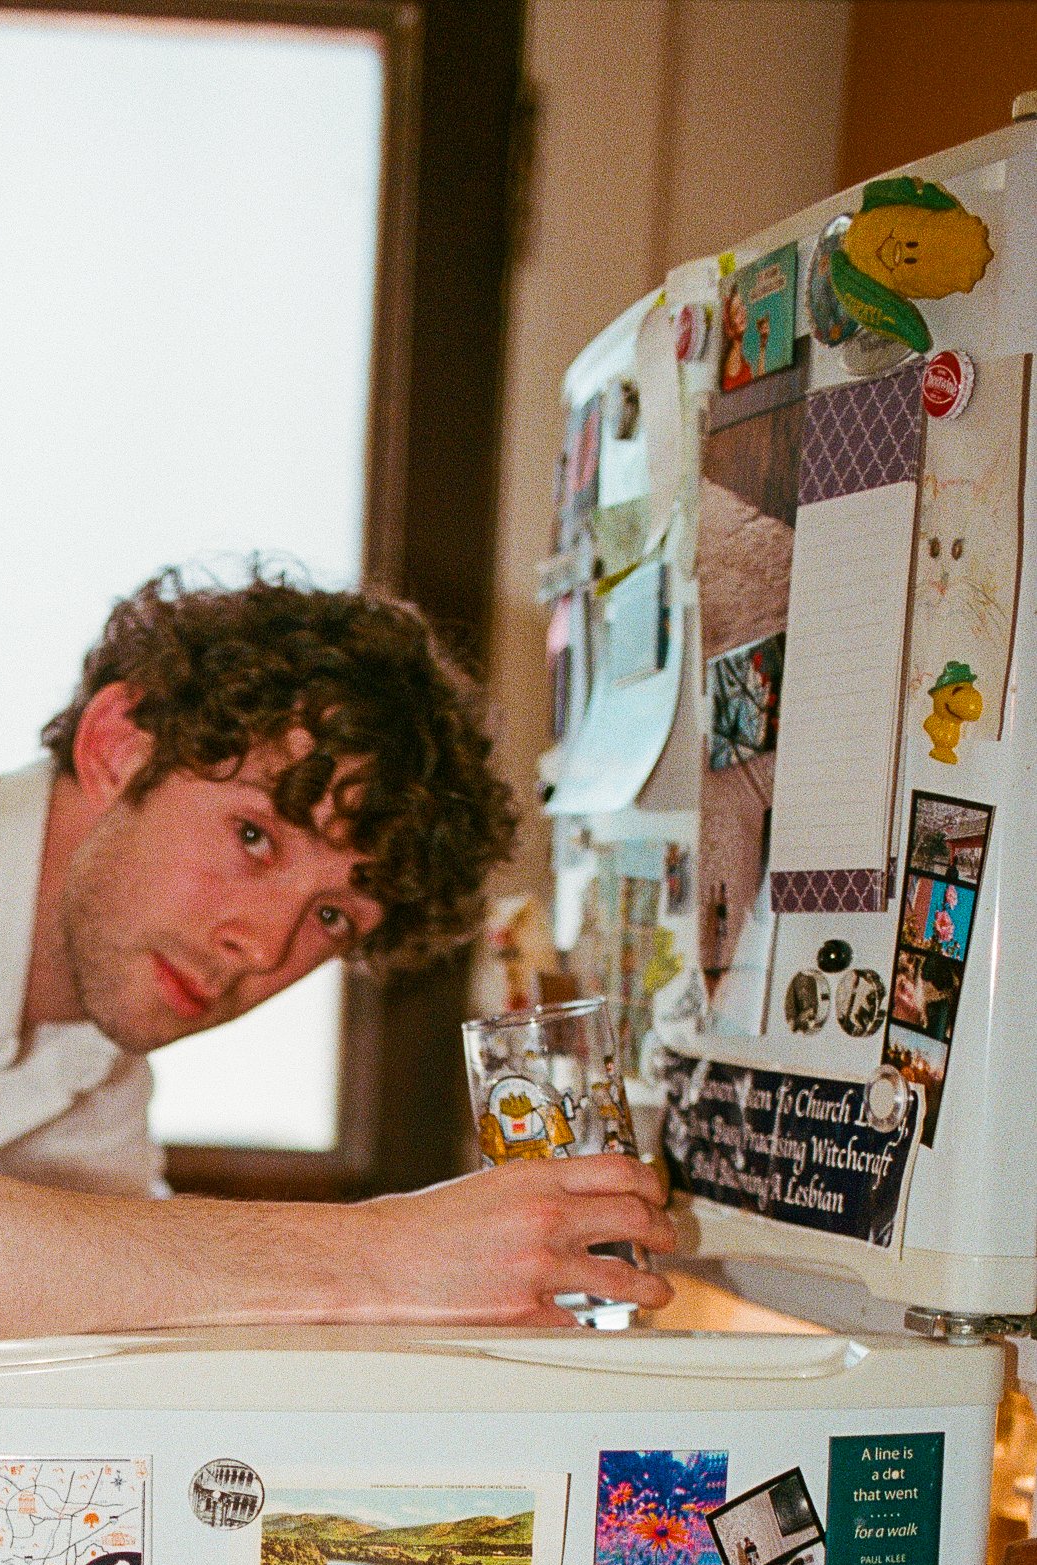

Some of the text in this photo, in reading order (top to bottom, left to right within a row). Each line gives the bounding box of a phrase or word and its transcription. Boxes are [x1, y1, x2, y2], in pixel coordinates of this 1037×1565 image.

[795, 1083, 853, 1124] Church
[811, 1135, 894, 1190] Witchcraft
[783, 1172, 845, 1214] Lesbian
[861, 1446, 913, 1461] A line is
[871, 1468, 905, 1481] a dot
[853, 1488, 919, 1502] that went
[854, 1523, 919, 1539] for a walk
[860, 1554, 907, 1564] PAUL KLEE
